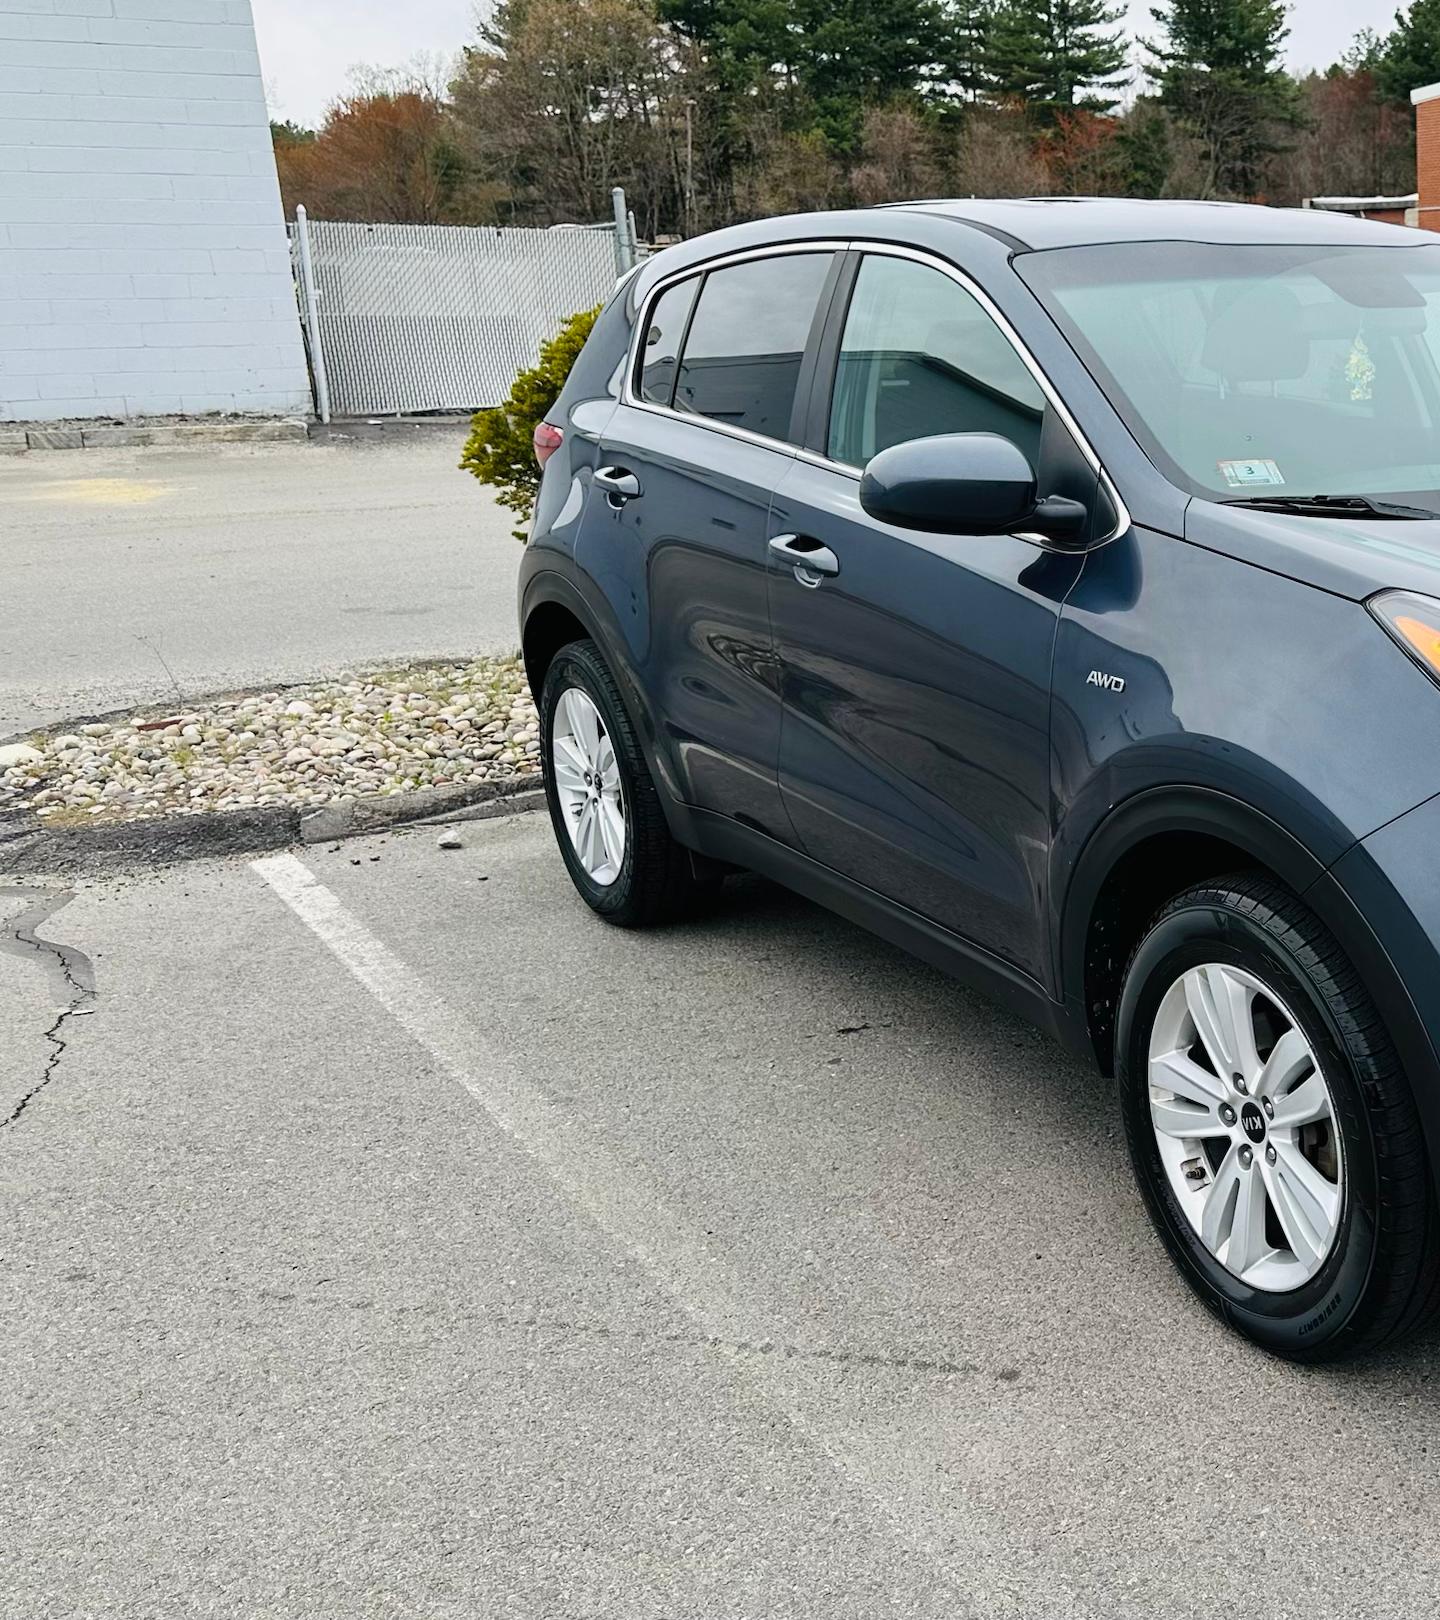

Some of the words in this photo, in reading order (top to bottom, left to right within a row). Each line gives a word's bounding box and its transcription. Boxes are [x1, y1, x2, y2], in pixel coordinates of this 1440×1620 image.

[1244, 466, 1255, 475] 3
[1086, 670, 1125, 693] AWD
[1242, 1115, 1263, 1131] KIA
